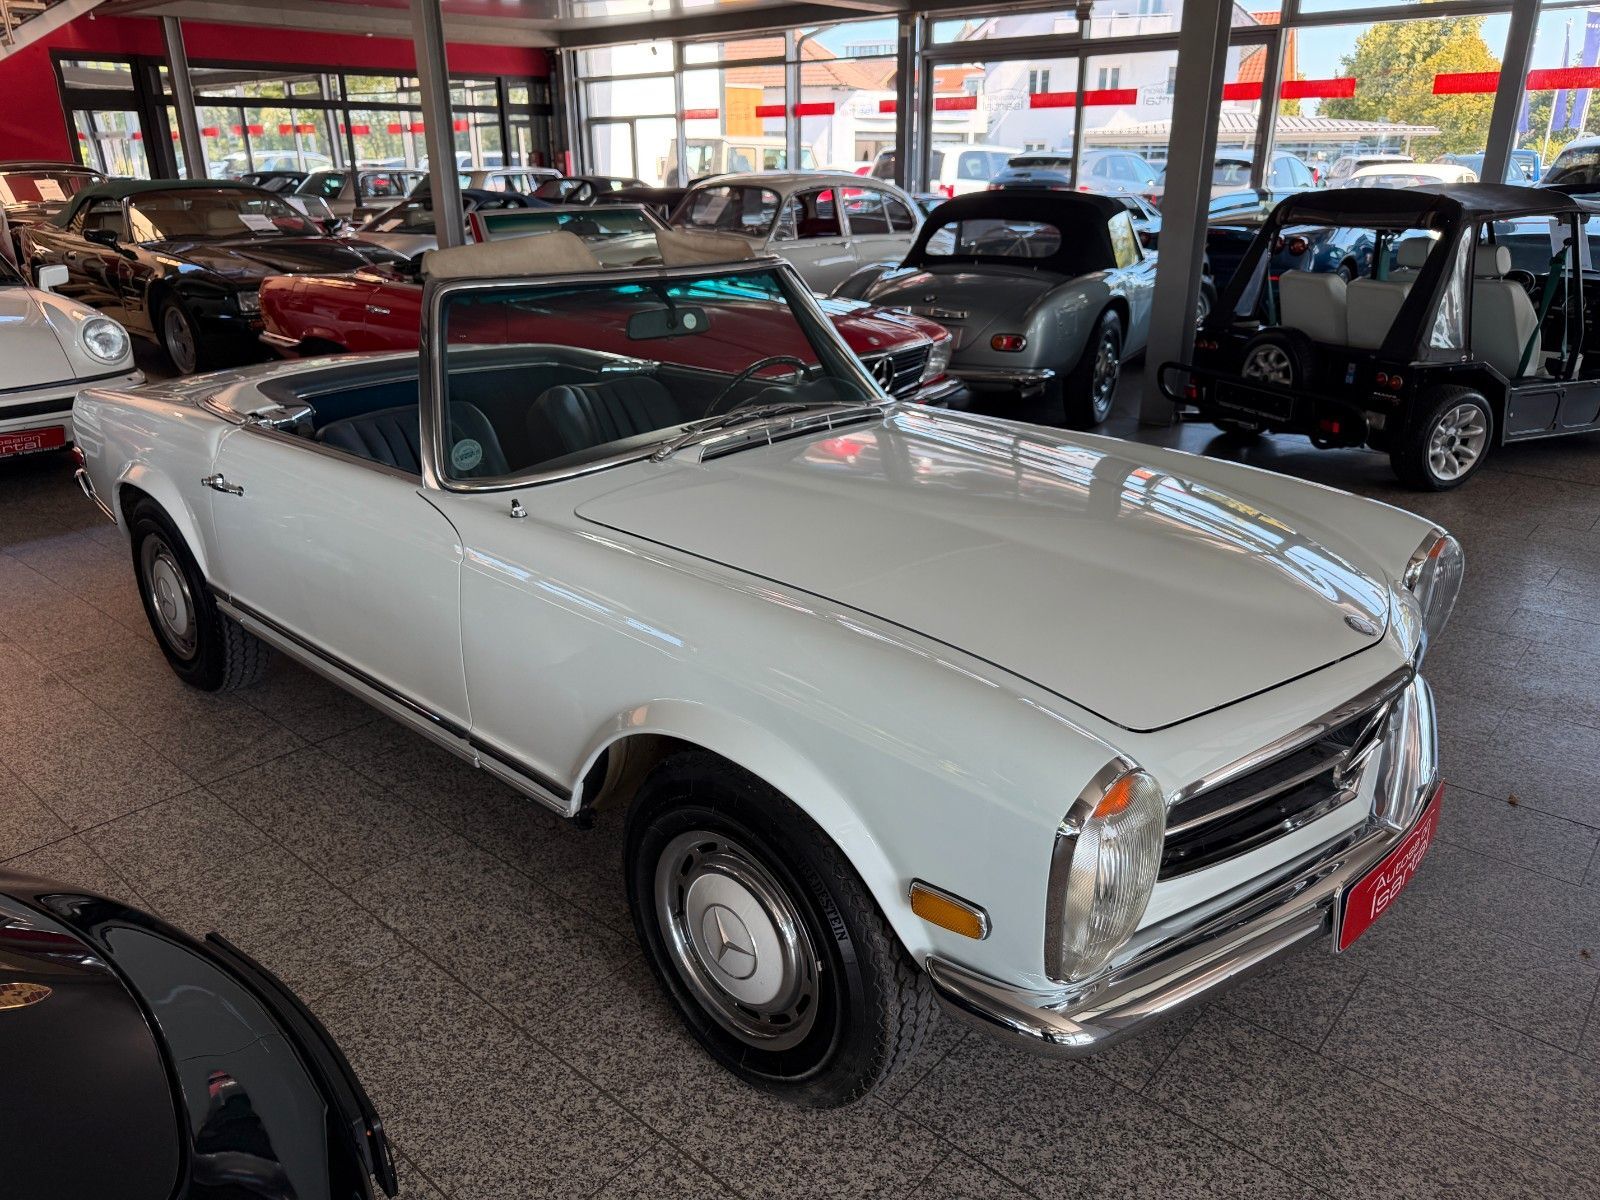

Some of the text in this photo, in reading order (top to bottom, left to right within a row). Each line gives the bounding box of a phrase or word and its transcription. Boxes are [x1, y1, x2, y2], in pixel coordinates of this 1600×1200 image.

[0, 437, 41, 453] rtal
[1370, 826, 1432, 919] Isartal
[1375, 818, 1431, 891] Autosaon
